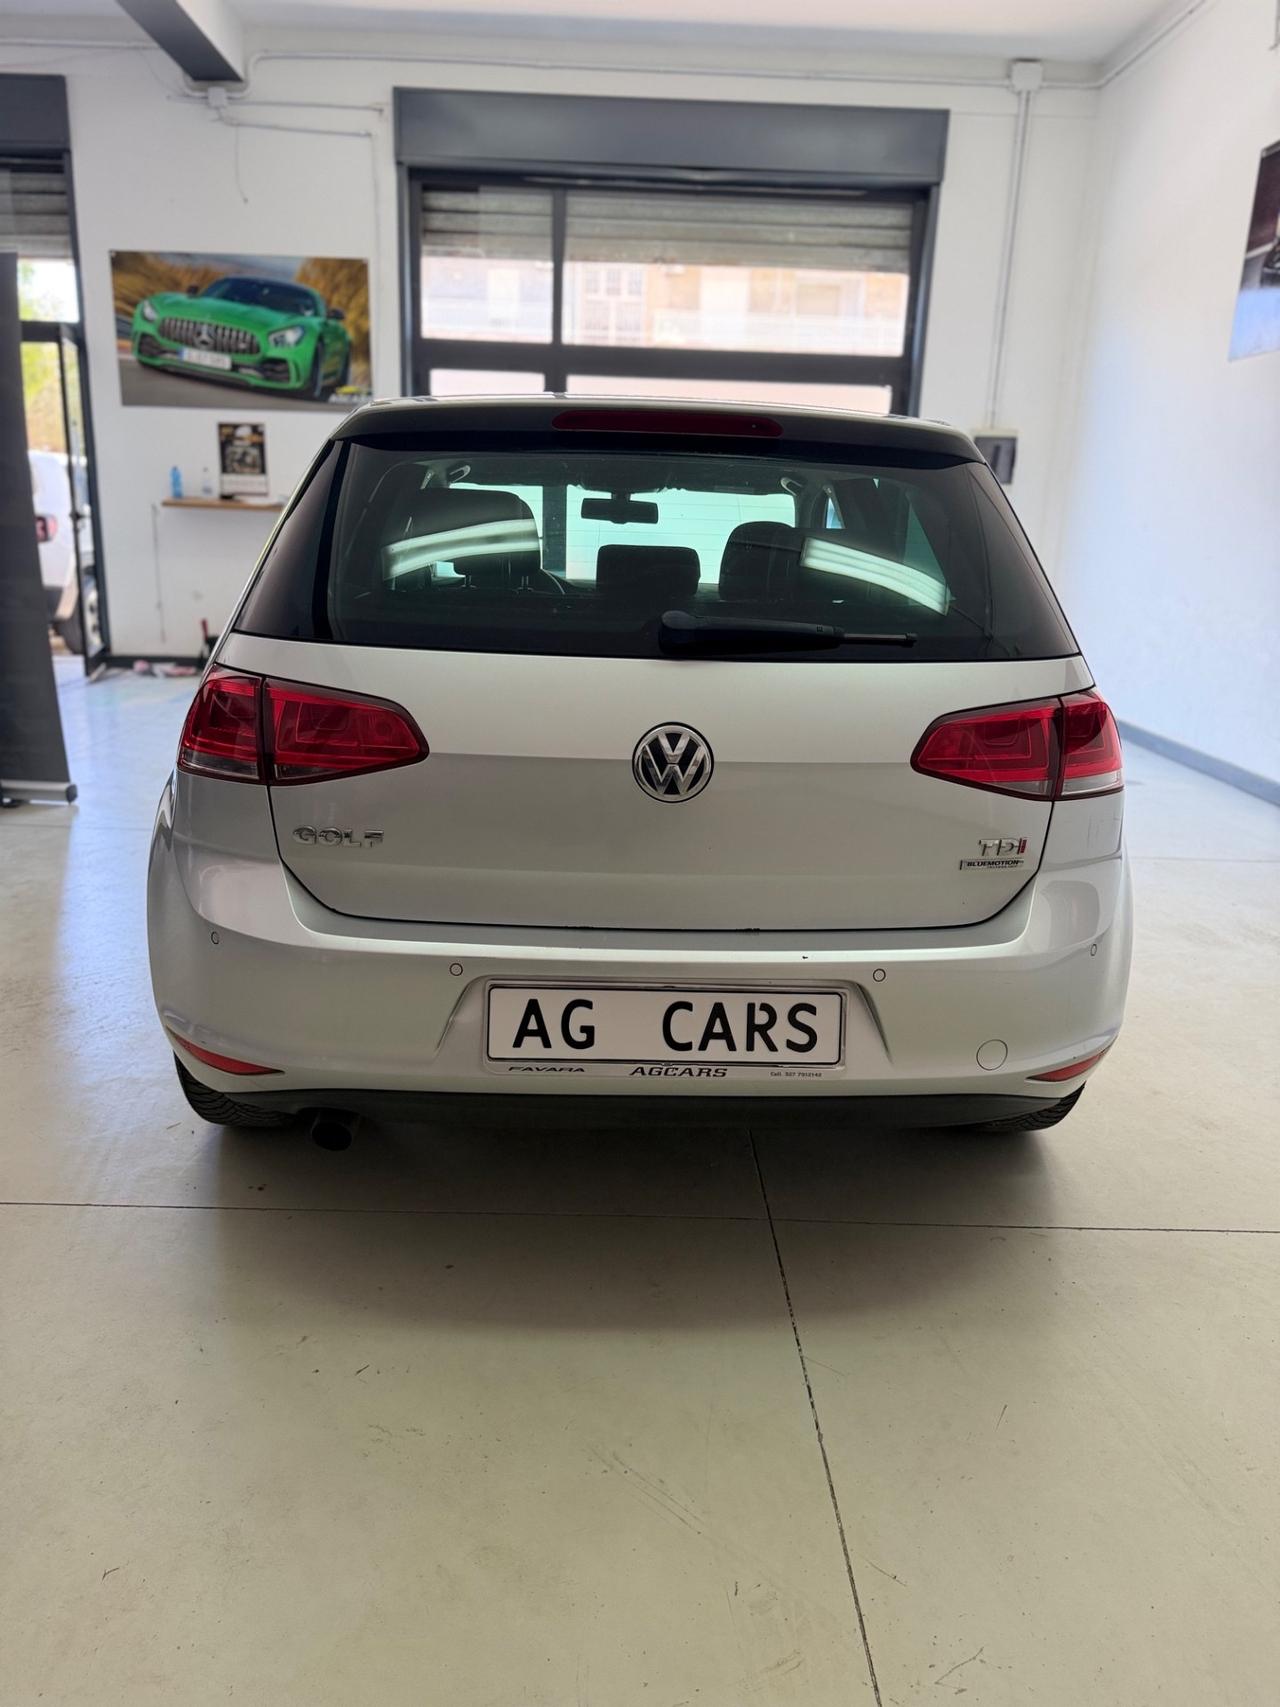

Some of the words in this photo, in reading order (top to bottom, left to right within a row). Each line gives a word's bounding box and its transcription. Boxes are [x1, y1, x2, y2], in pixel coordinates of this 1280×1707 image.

[633, 722, 714, 803] VW
[292, 825, 384, 848] GOLF
[966, 859, 1020, 867] BLUEMOTION
[512, 998, 596, 1050] AG
[661, 1000, 818, 1053] CARS
[629, 1066, 728, 1077] AGCARS
